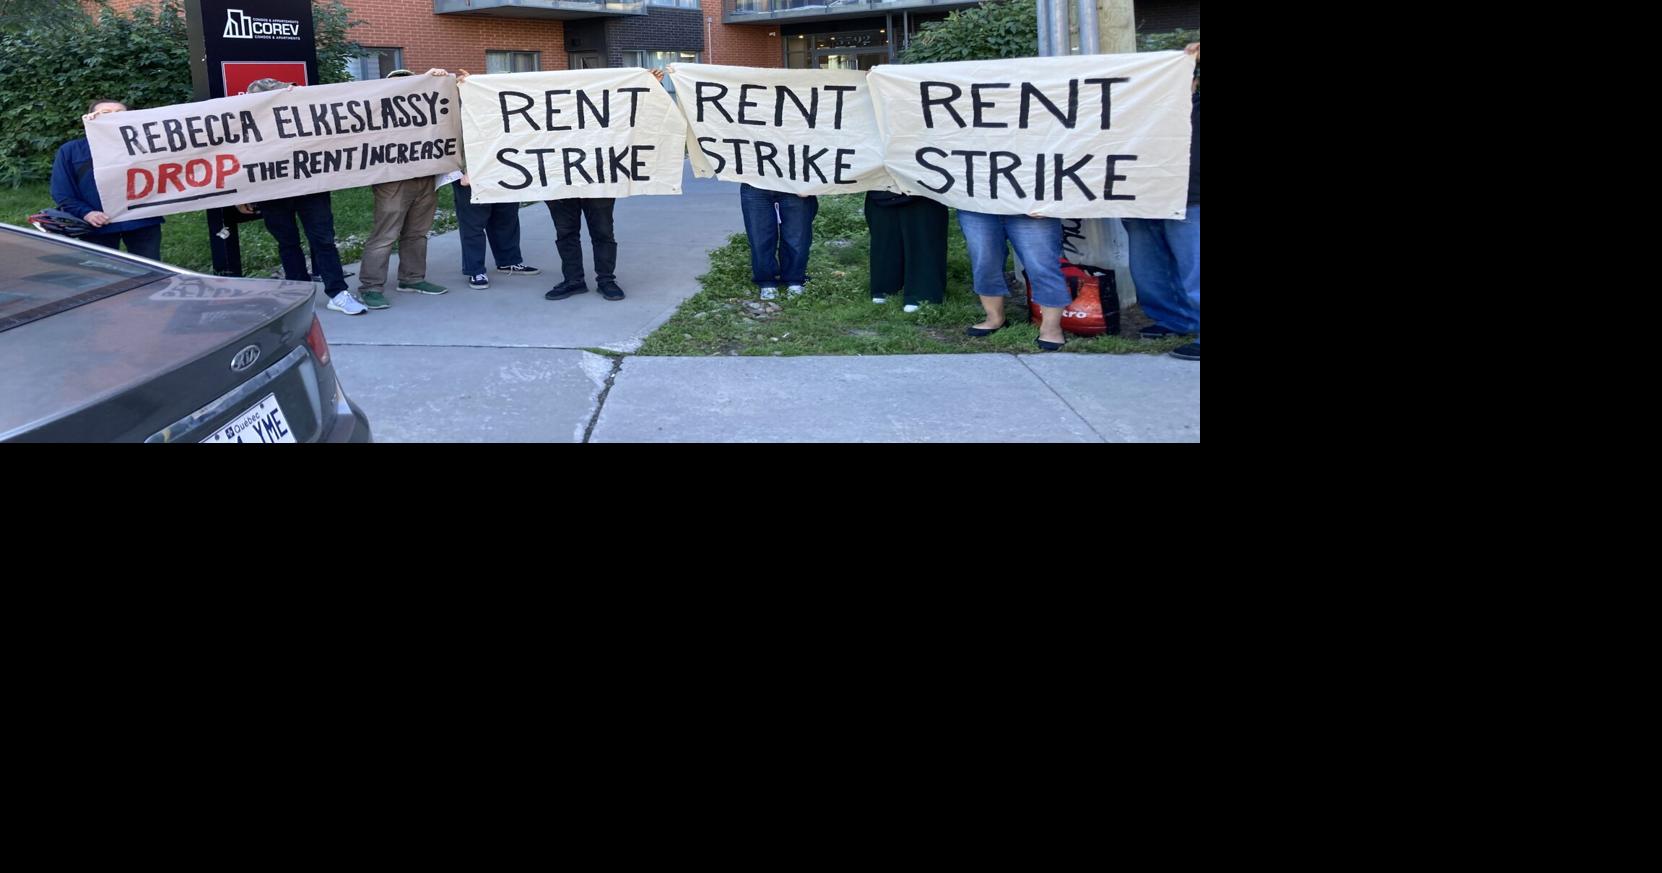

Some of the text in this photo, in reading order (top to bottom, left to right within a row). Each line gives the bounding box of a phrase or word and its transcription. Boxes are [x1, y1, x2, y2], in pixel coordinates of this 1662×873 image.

[252, 21, 299, 36] COREV
[119, 91, 450, 156] REBECCA ELKESLASSY:
[498, 87, 650, 133] RENT
[695, 81, 857, 130] RENT
[920, 77, 1131, 130] RENT
[126, 138, 457, 200] DROP THE RENT INCREASE
[496, 145, 655, 190] STRIKE
[697, 137, 857, 184] STRIKE
[915, 146, 1138, 201] STRIKE
[1062, 309, 1087, 319] tro
[234, 348, 259, 369] KIA
[234, 411, 260, 434] Québec
